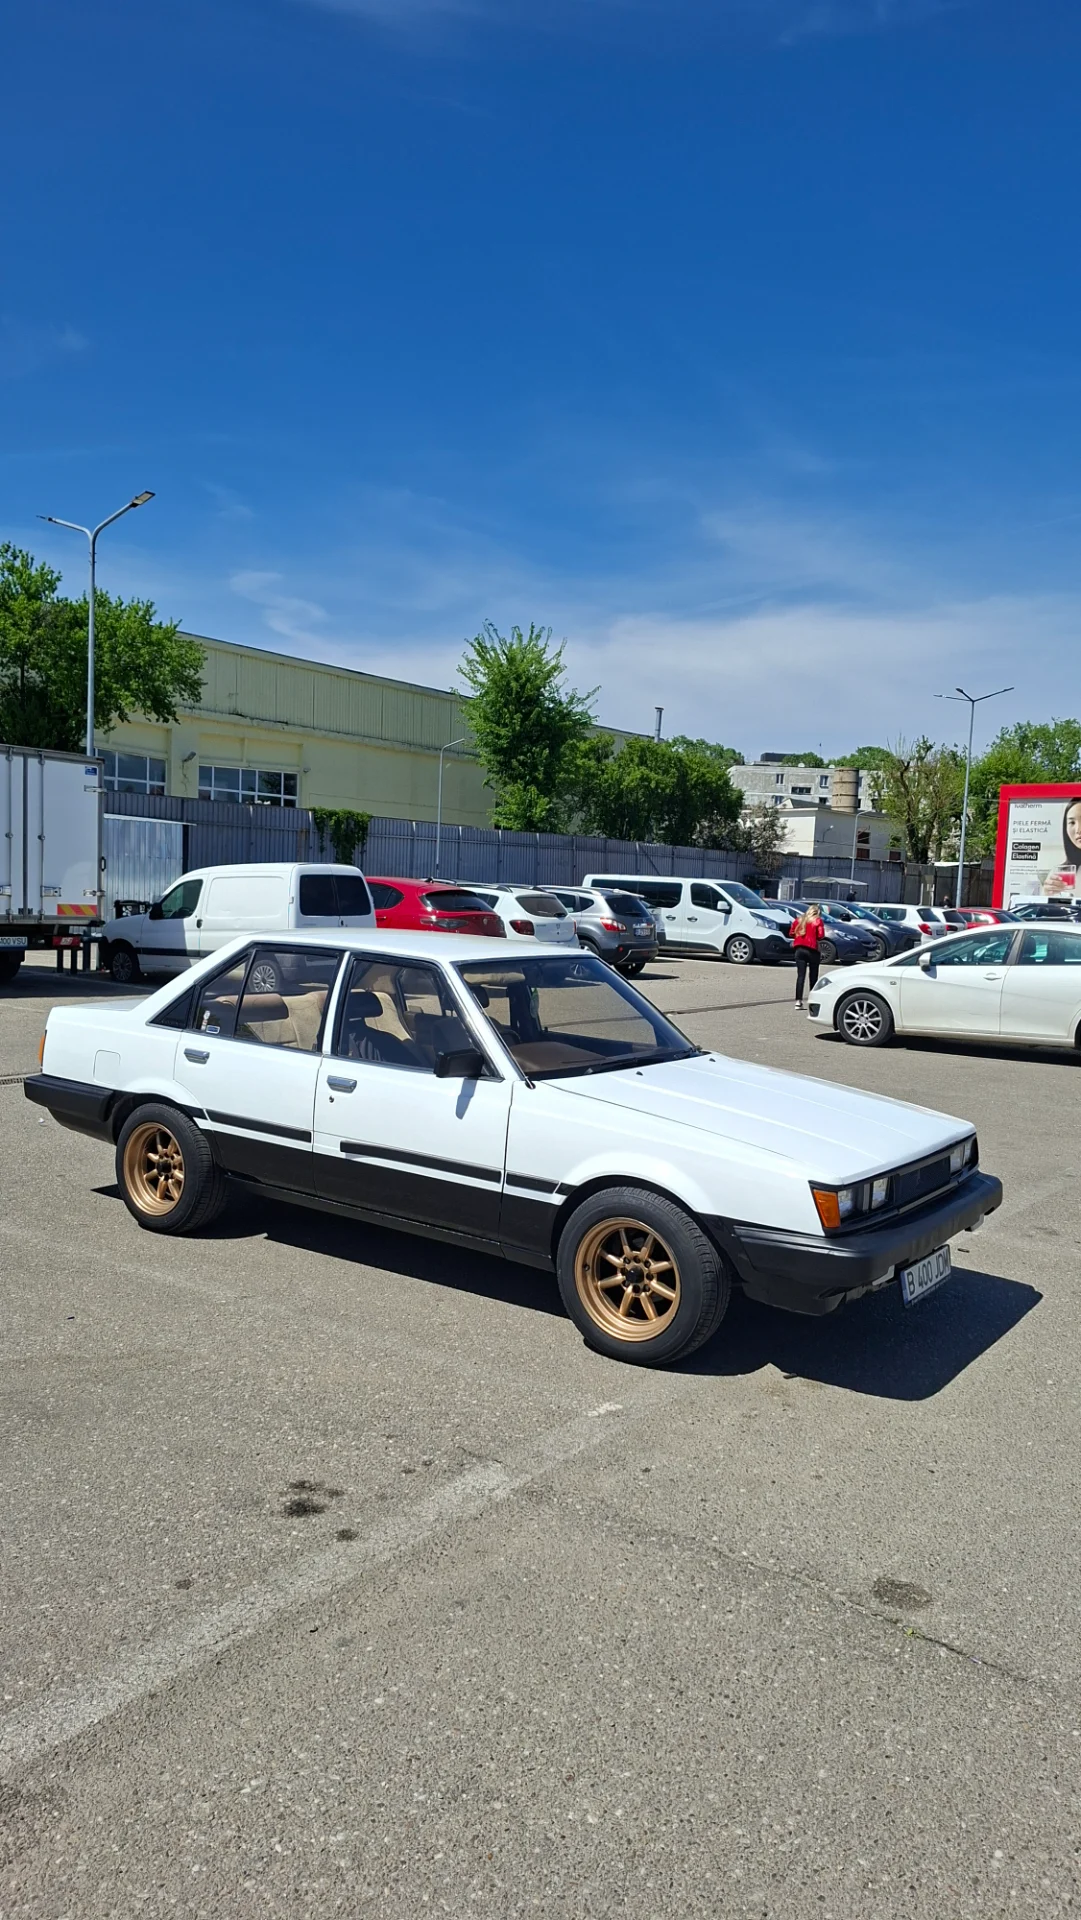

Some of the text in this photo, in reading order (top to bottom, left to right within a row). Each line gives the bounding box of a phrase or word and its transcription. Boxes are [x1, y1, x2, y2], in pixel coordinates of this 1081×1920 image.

[1013, 843, 1039, 851] Colagen
[12, 937, 27, 945] VSU
[906, 1271, 915, 1297] B
[918, 1260, 933, 1289] 400
[935, 1248, 950, 1279] JDM
